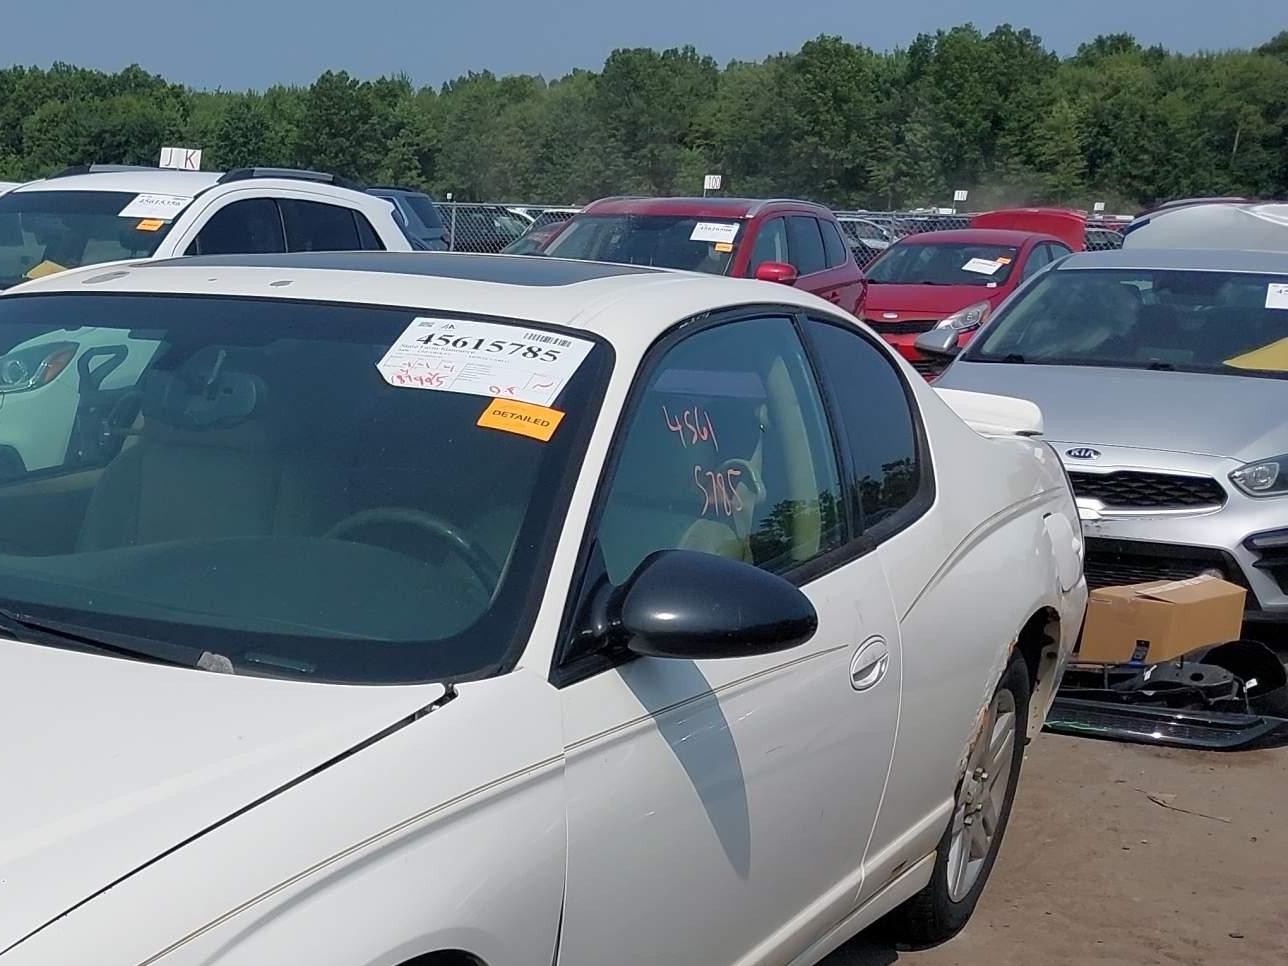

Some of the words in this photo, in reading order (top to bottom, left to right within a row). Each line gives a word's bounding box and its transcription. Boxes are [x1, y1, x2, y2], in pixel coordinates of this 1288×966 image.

[184, 150, 197, 169] K
[415, 332, 561, 363] 45615785
[492, 409, 551, 428] DETAILED
[661, 405, 720, 453] 4561
[693, 465, 744, 518] 5785
